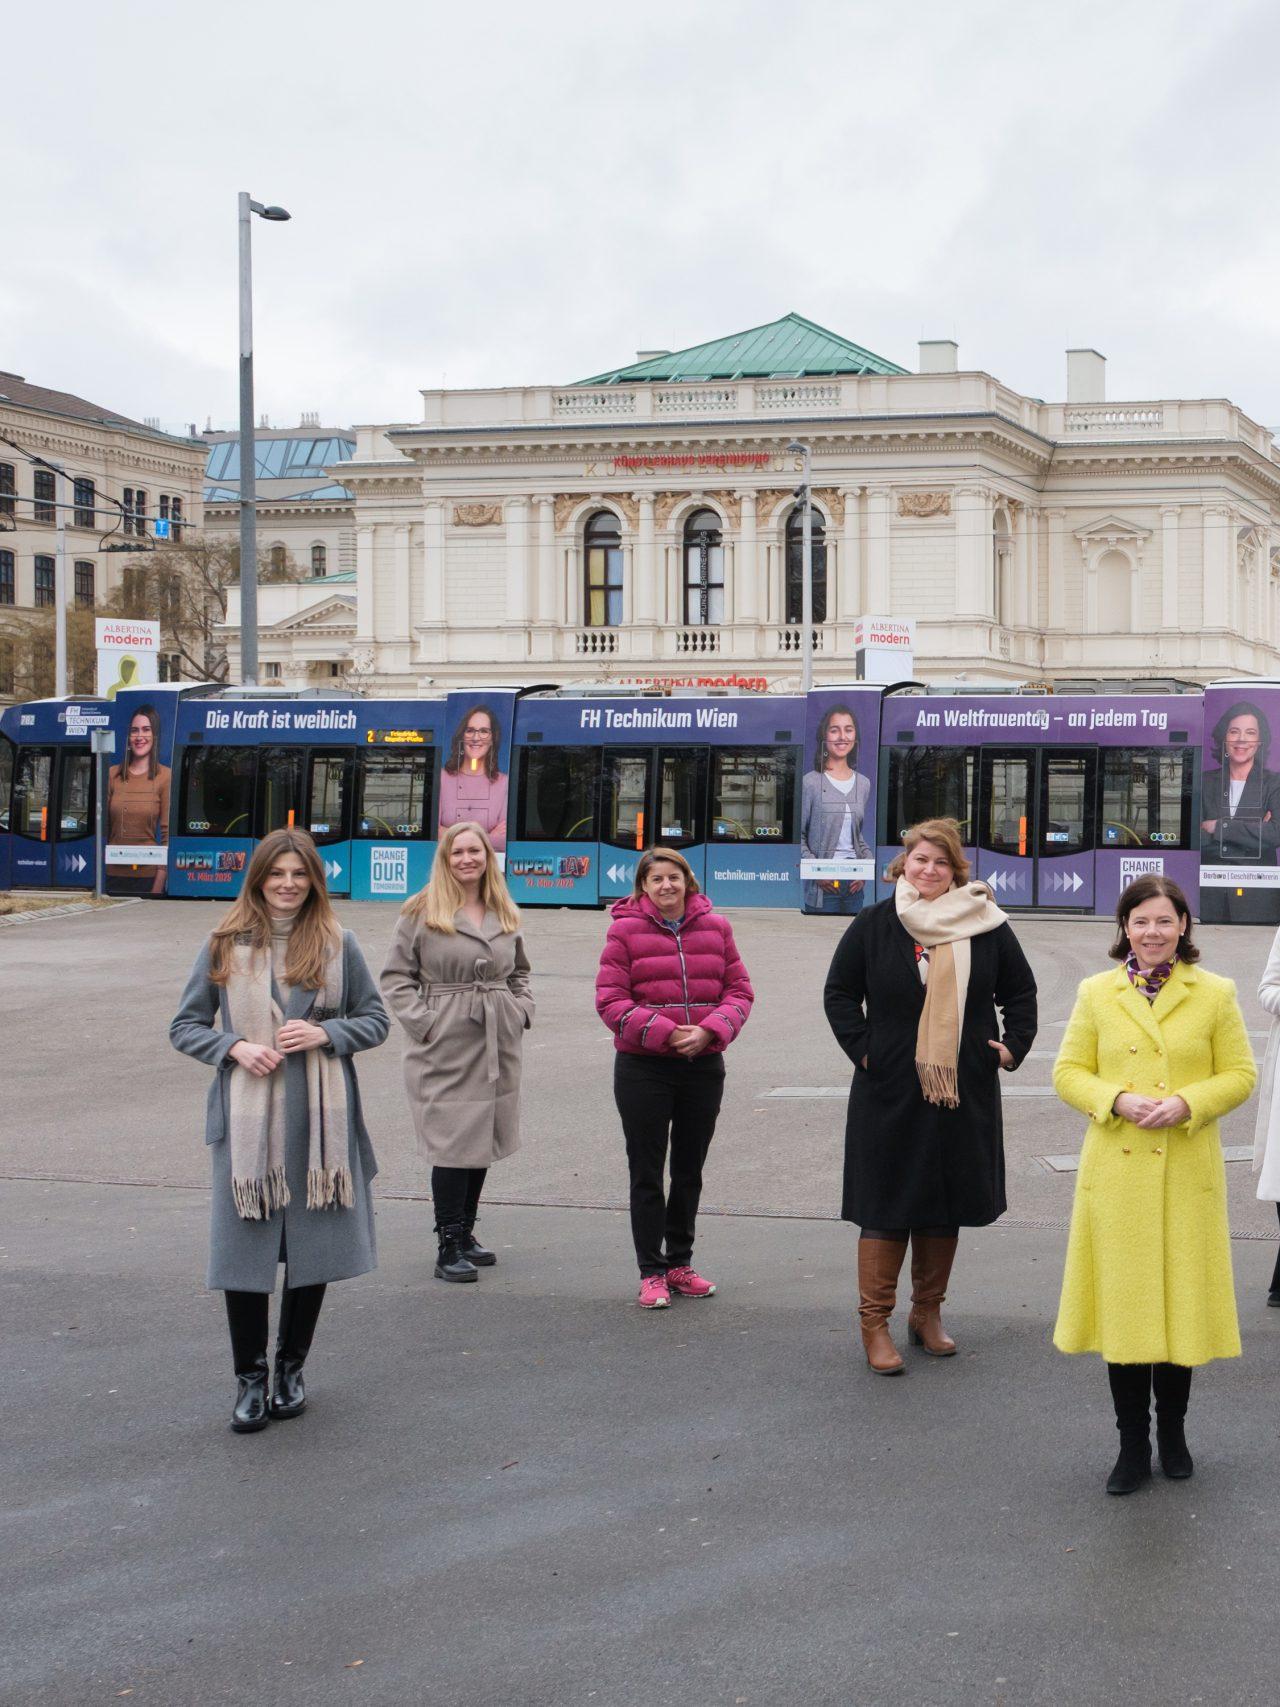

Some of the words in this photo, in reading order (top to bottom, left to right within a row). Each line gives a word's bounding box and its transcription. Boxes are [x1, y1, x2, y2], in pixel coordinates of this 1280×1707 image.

[103, 624, 152, 635] ALBERTINA
[870, 622, 910, 634] ALBERTINA
[103, 633, 153, 646] modern
[870, 633, 910, 645] modern
[697, 673, 768, 691] modern
[69, 717, 107, 725] TECHNIKUM
[206, 710, 229, 729] Die
[232, 709, 269, 729] Kraft
[272, 710, 290, 729] ist
[294, 709, 357, 729] weiblich
[580, 708, 600, 728] FH
[605, 707, 692, 728] Technikum
[696, 707, 738, 728] Wien
[916, 709, 940, 727] Am
[943, 709, 1050, 730] Weltfrauentag
[1068, 712, 1086, 727] an
[1089, 709, 1137, 730] jedem
[1140, 709, 1168, 730] Tag
[367, 730, 375, 743] 2
[176, 851, 213, 870] OPEN
[373, 850, 405, 861] CHANGE
[373, 862, 405, 881] OUR
[513, 857, 554, 876] OPEN
[1122, 860, 1161, 872] CHANGE
[714, 869, 790, 881] technikum-wien.at
